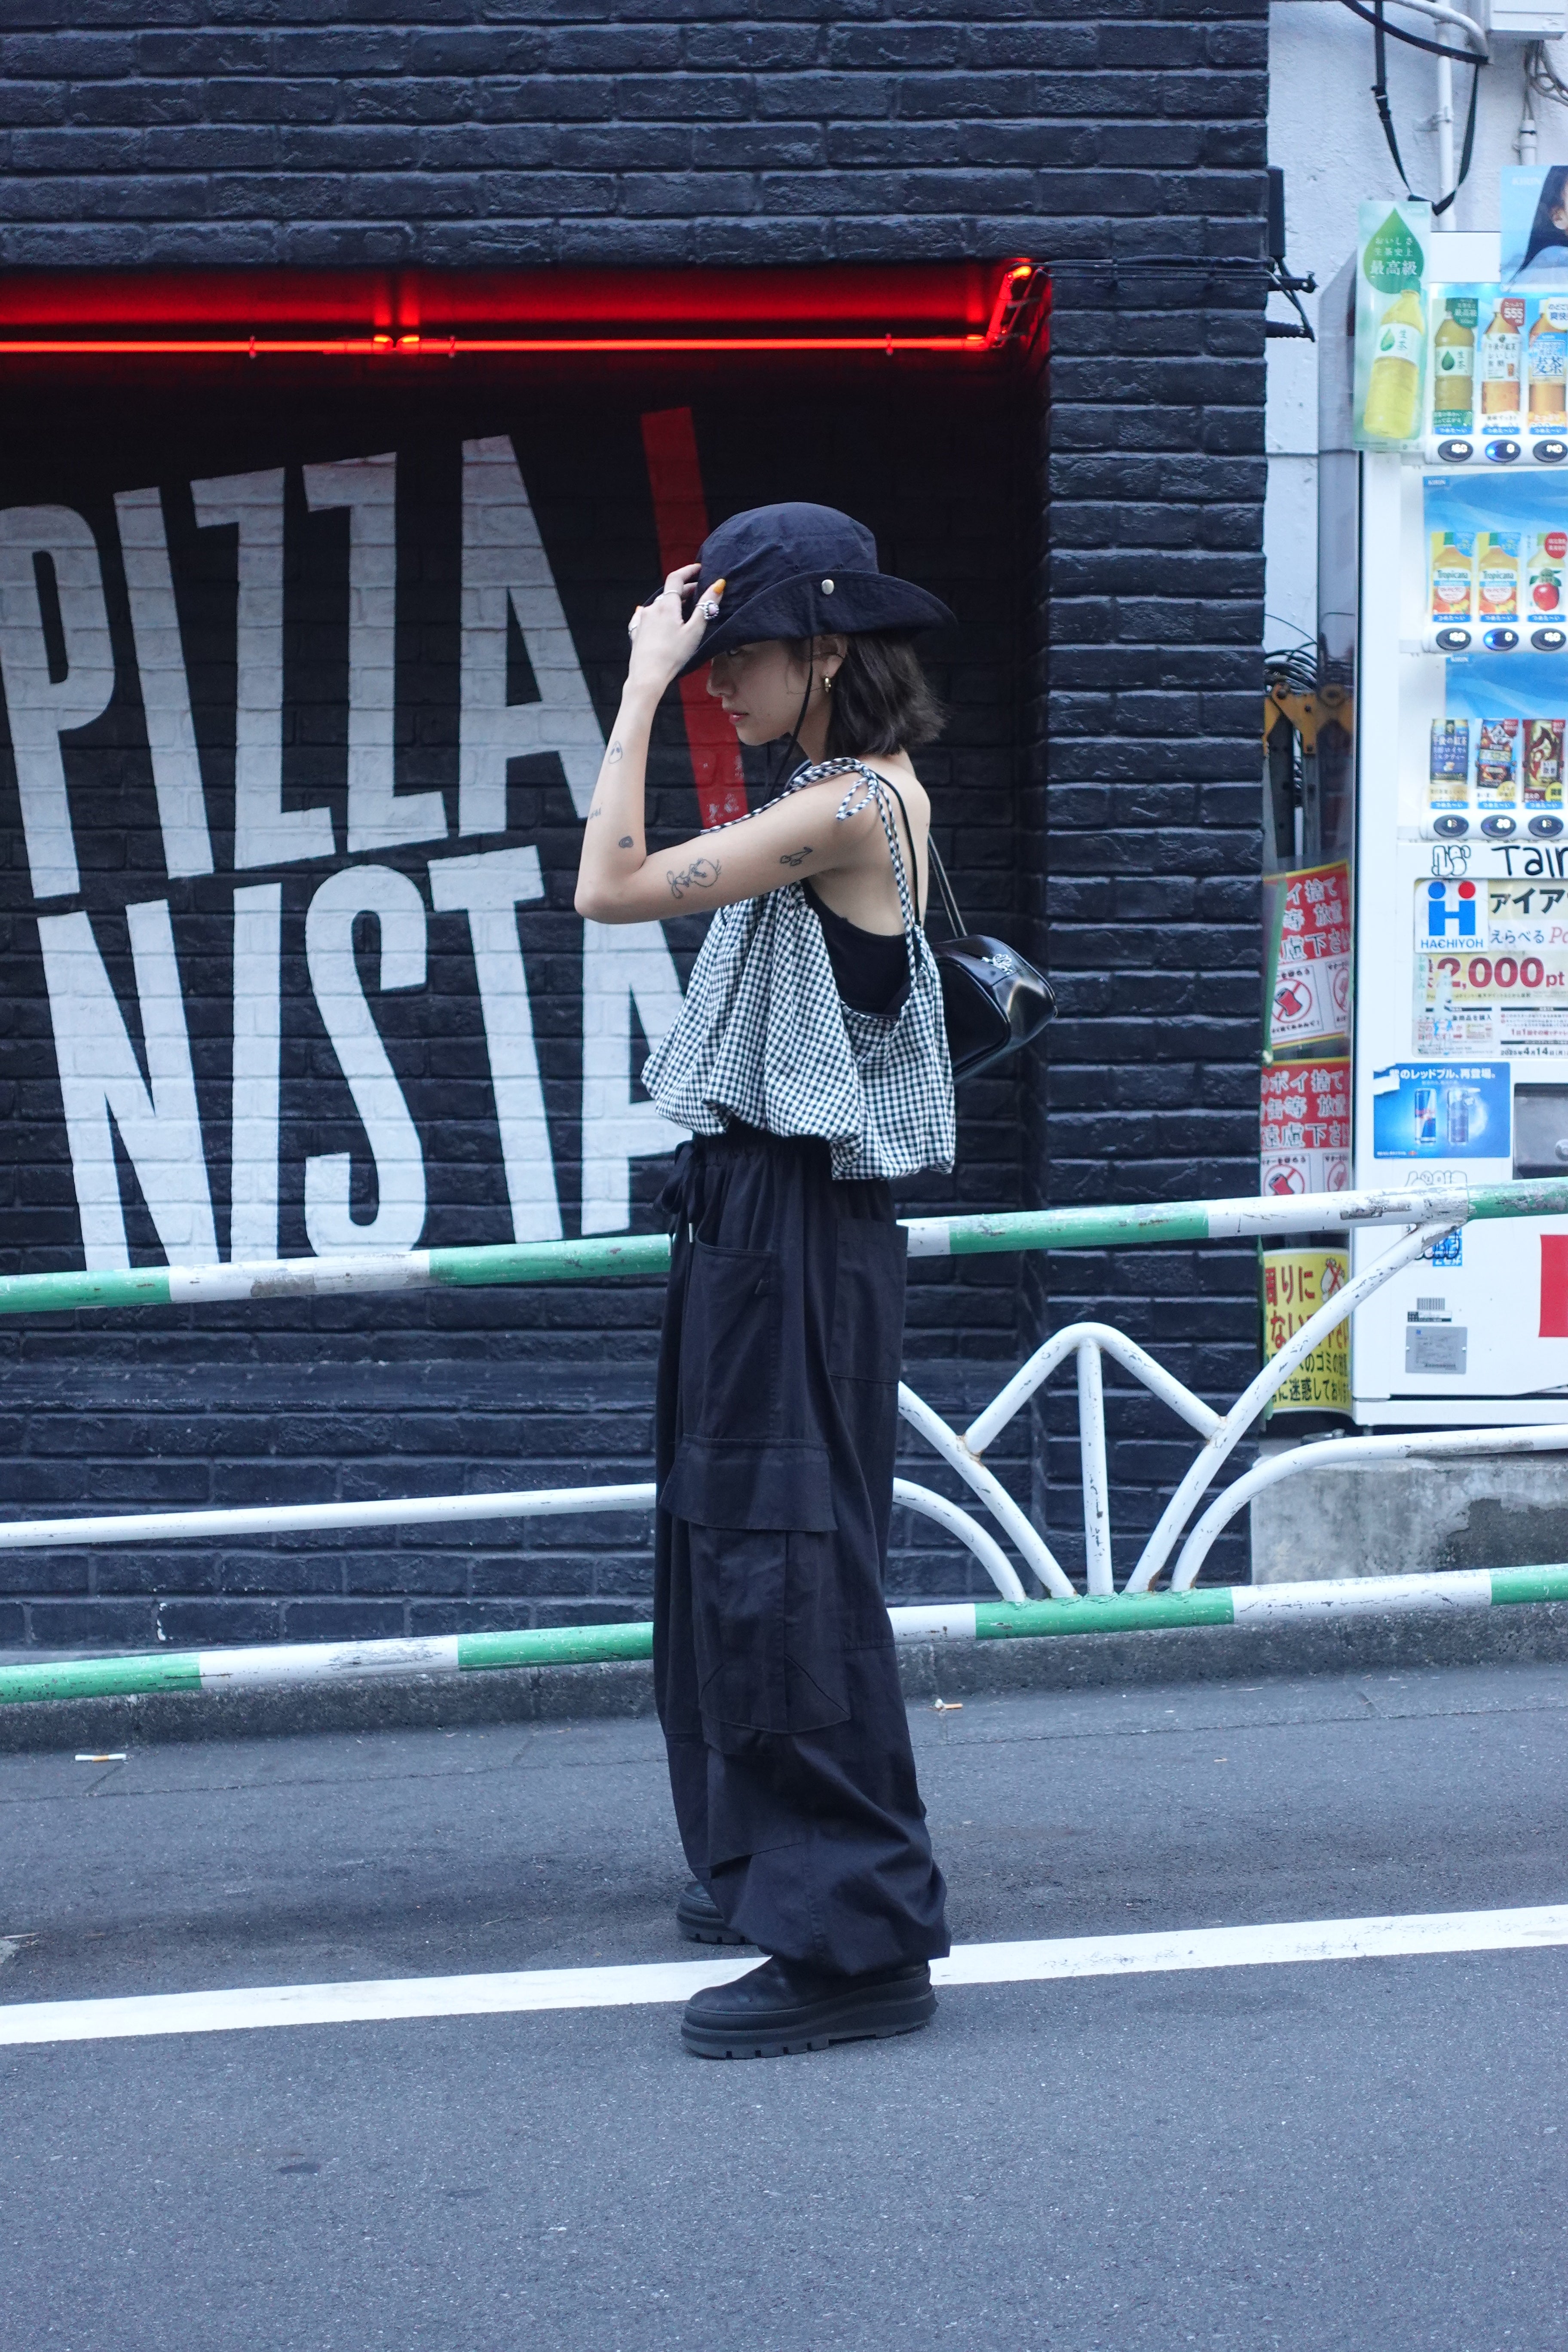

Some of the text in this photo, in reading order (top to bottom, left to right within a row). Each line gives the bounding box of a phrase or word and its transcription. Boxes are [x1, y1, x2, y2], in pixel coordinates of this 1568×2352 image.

[1370, 260, 1417, 276] 最高級
[1504, 307, 1523, 319] 555
[1536, 356, 1564, 373] 麦茶
[1437, 570, 1468, 579] Tropicana
[1483, 570, 1514, 580] Tropicana
[0, 435, 611, 898] PIZZA
[1491, 930, 1544, 943] えらべる
[1421, 939, 1483, 948] HACHIYOH
[37, 845, 694, 1271] NISTA
